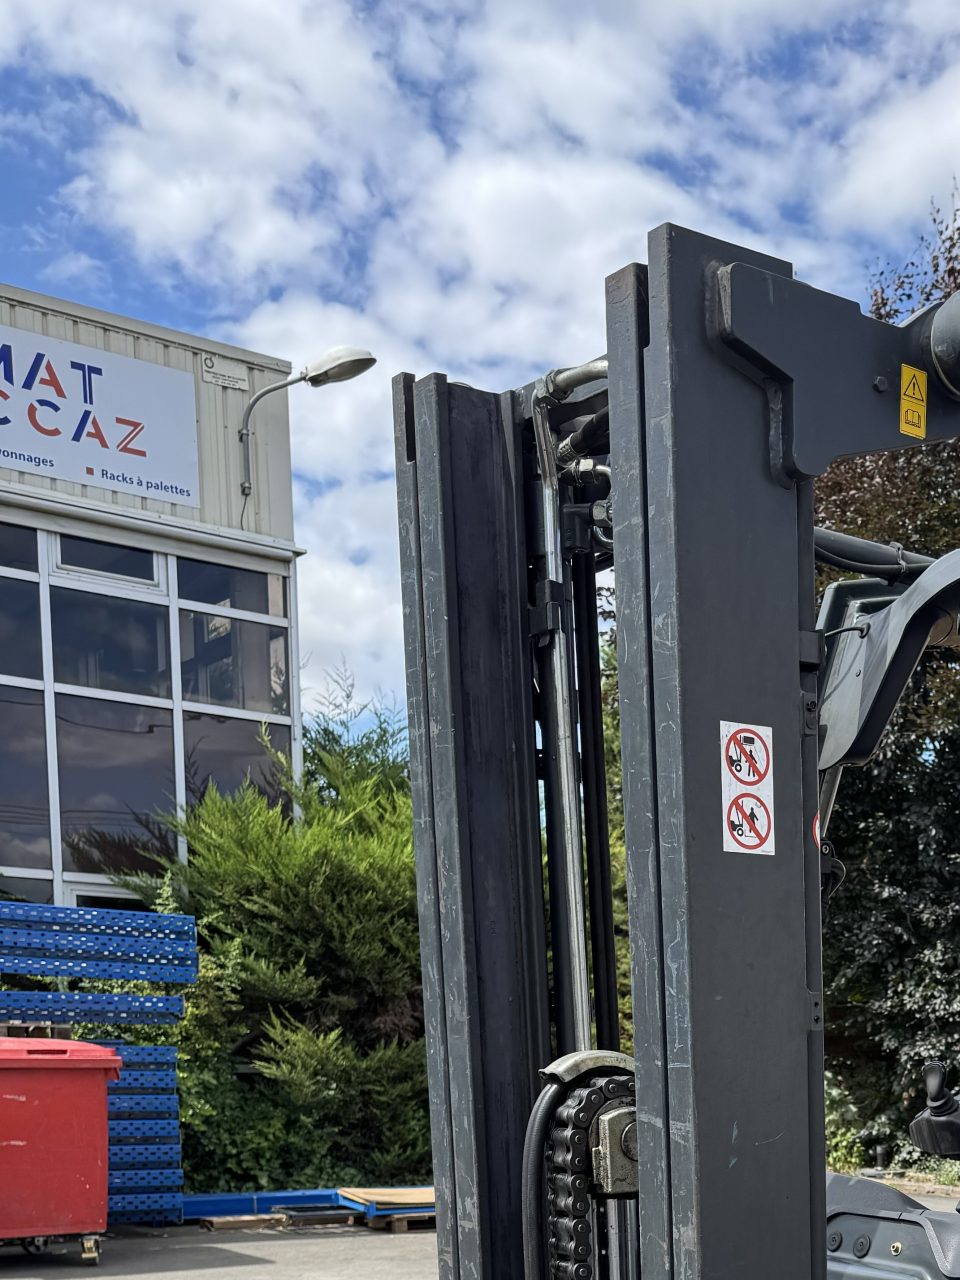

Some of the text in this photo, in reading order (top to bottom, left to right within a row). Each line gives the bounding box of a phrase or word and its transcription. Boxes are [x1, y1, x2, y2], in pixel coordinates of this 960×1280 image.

[0, 449, 191, 496] onnages Racks à palettes
